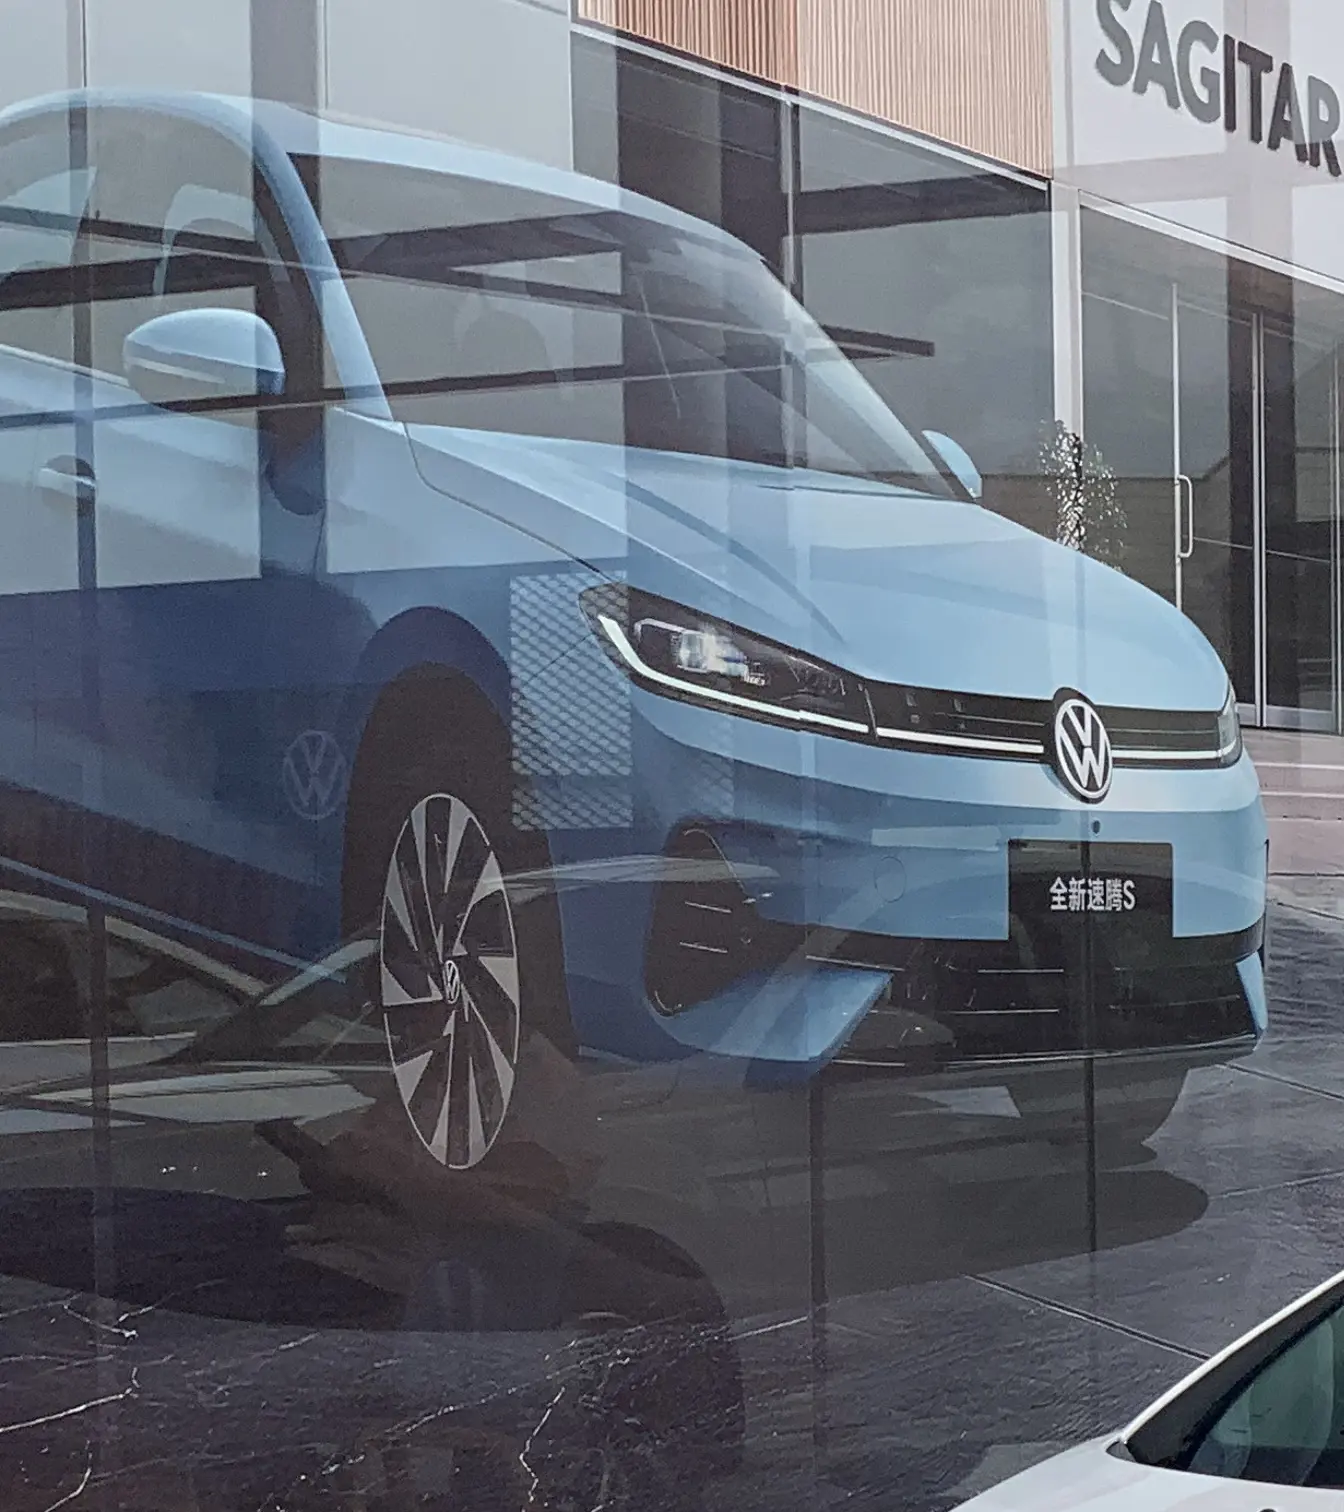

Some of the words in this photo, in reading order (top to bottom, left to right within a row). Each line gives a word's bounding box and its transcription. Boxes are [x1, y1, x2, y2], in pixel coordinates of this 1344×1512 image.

[1095, 0, 1342, 178] SAGITAR
[1049, 876, 1136, 912] 全新速腾S
